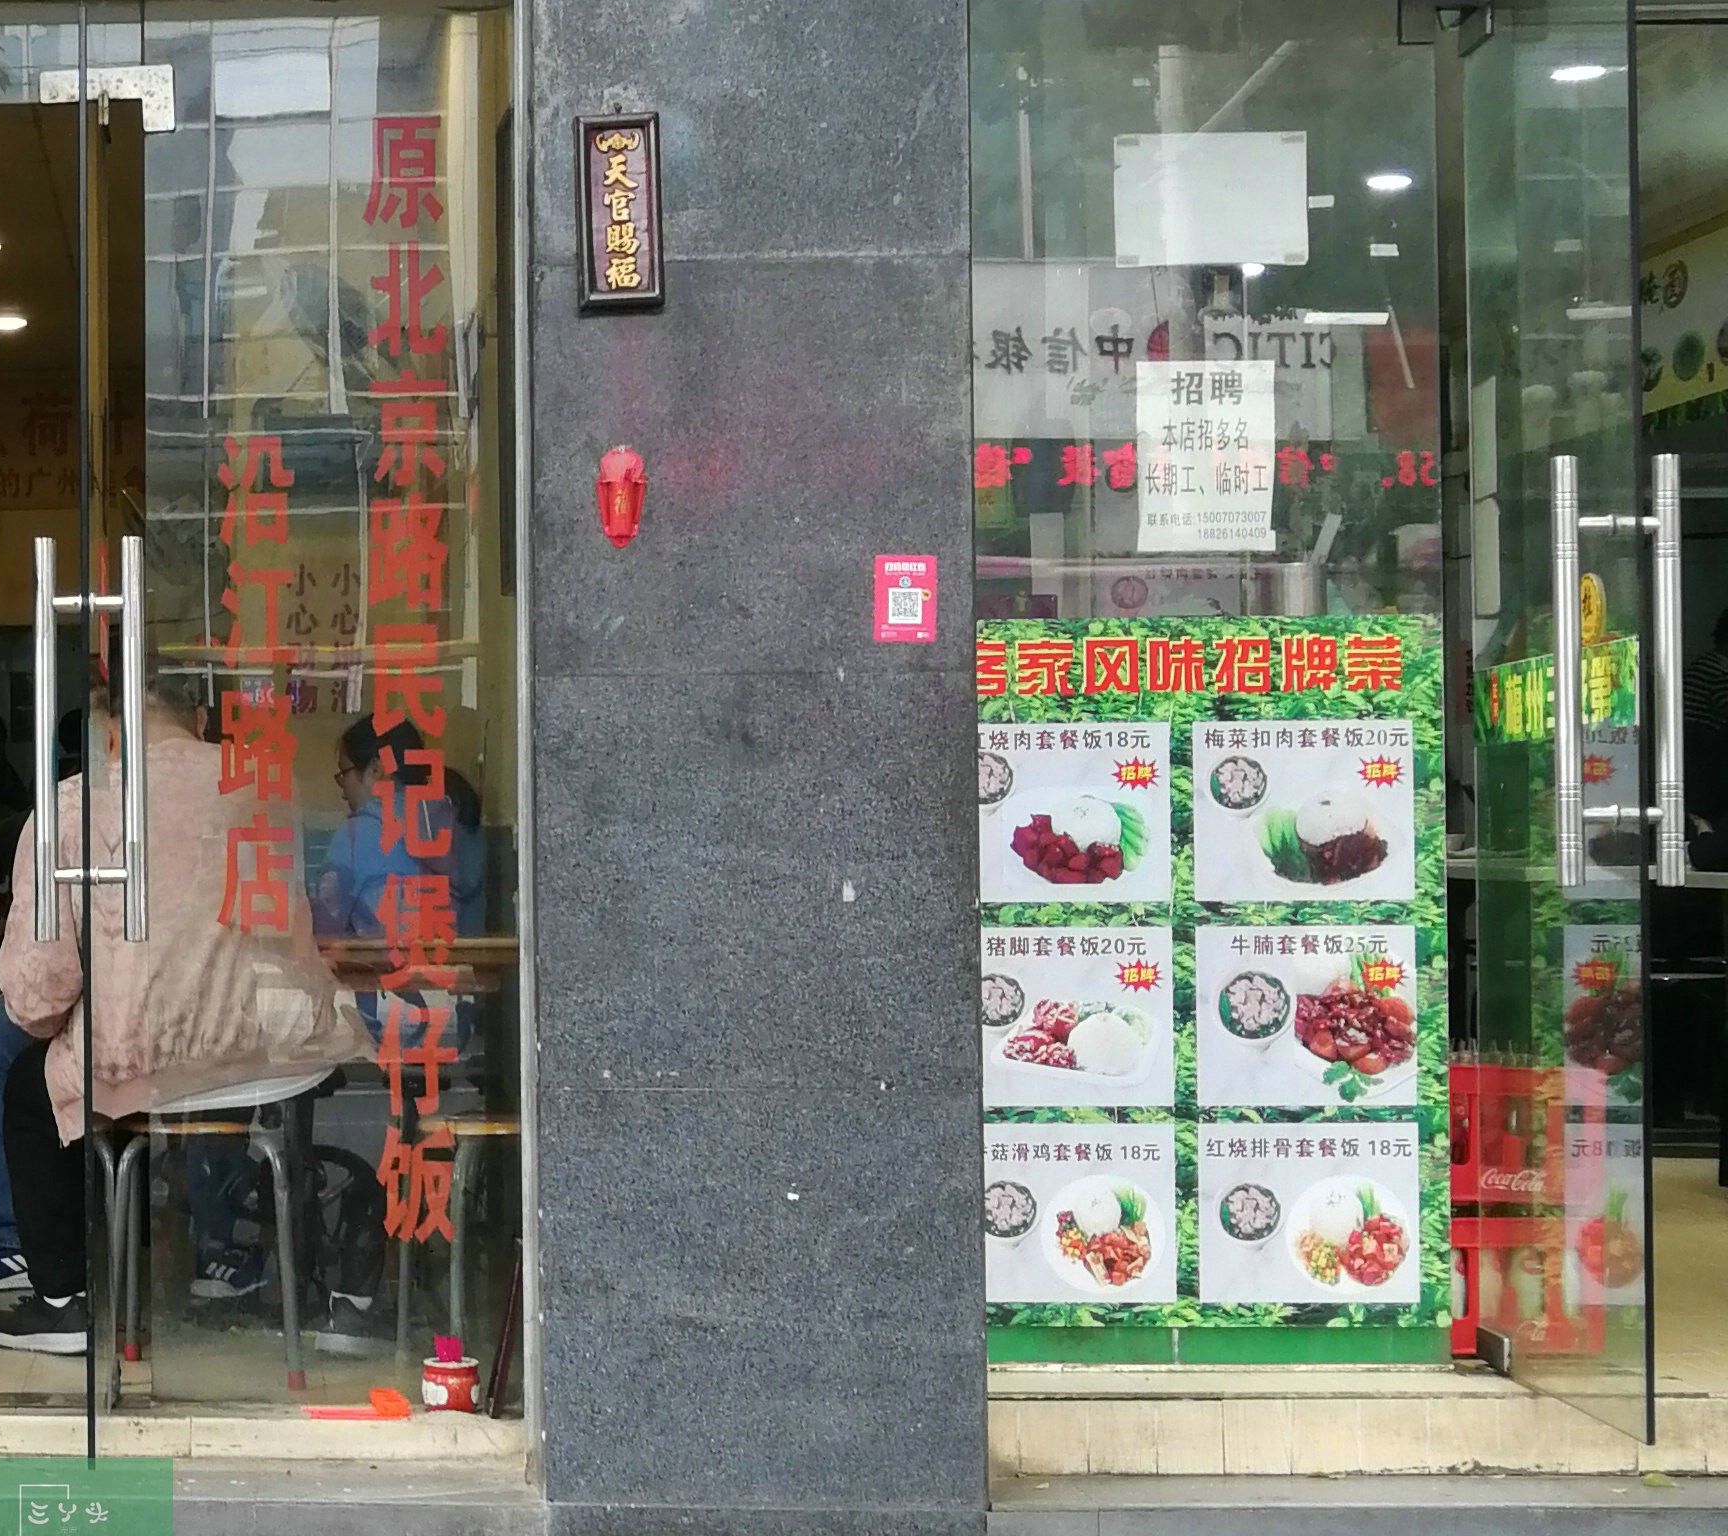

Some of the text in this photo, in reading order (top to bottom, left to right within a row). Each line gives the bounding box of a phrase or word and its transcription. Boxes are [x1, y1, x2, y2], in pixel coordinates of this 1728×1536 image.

[1171, 370, 1244, 406] 招聘
[1161, 417, 1249, 452] 本店招多名
[1144, 461, 1269, 496] 长期工、临时工
[217, 436, 298, 934] 沿江路店
[364, 115, 460, 1244] 原北京路民记煲仔饭
[1204, 728, 1410, 749] 梅菜扣肉套餐饭20元
[985, 936, 1148, 958] 猪脚套餐饭20元
[1229, 933, 1390, 956] 牛腩套餐饭25元
[982, 1143, 1162, 1163] 菇滑鸡套餐饭 18元
[1205, 1138, 1413, 1159] 红烧排骨套餐饭 18元
